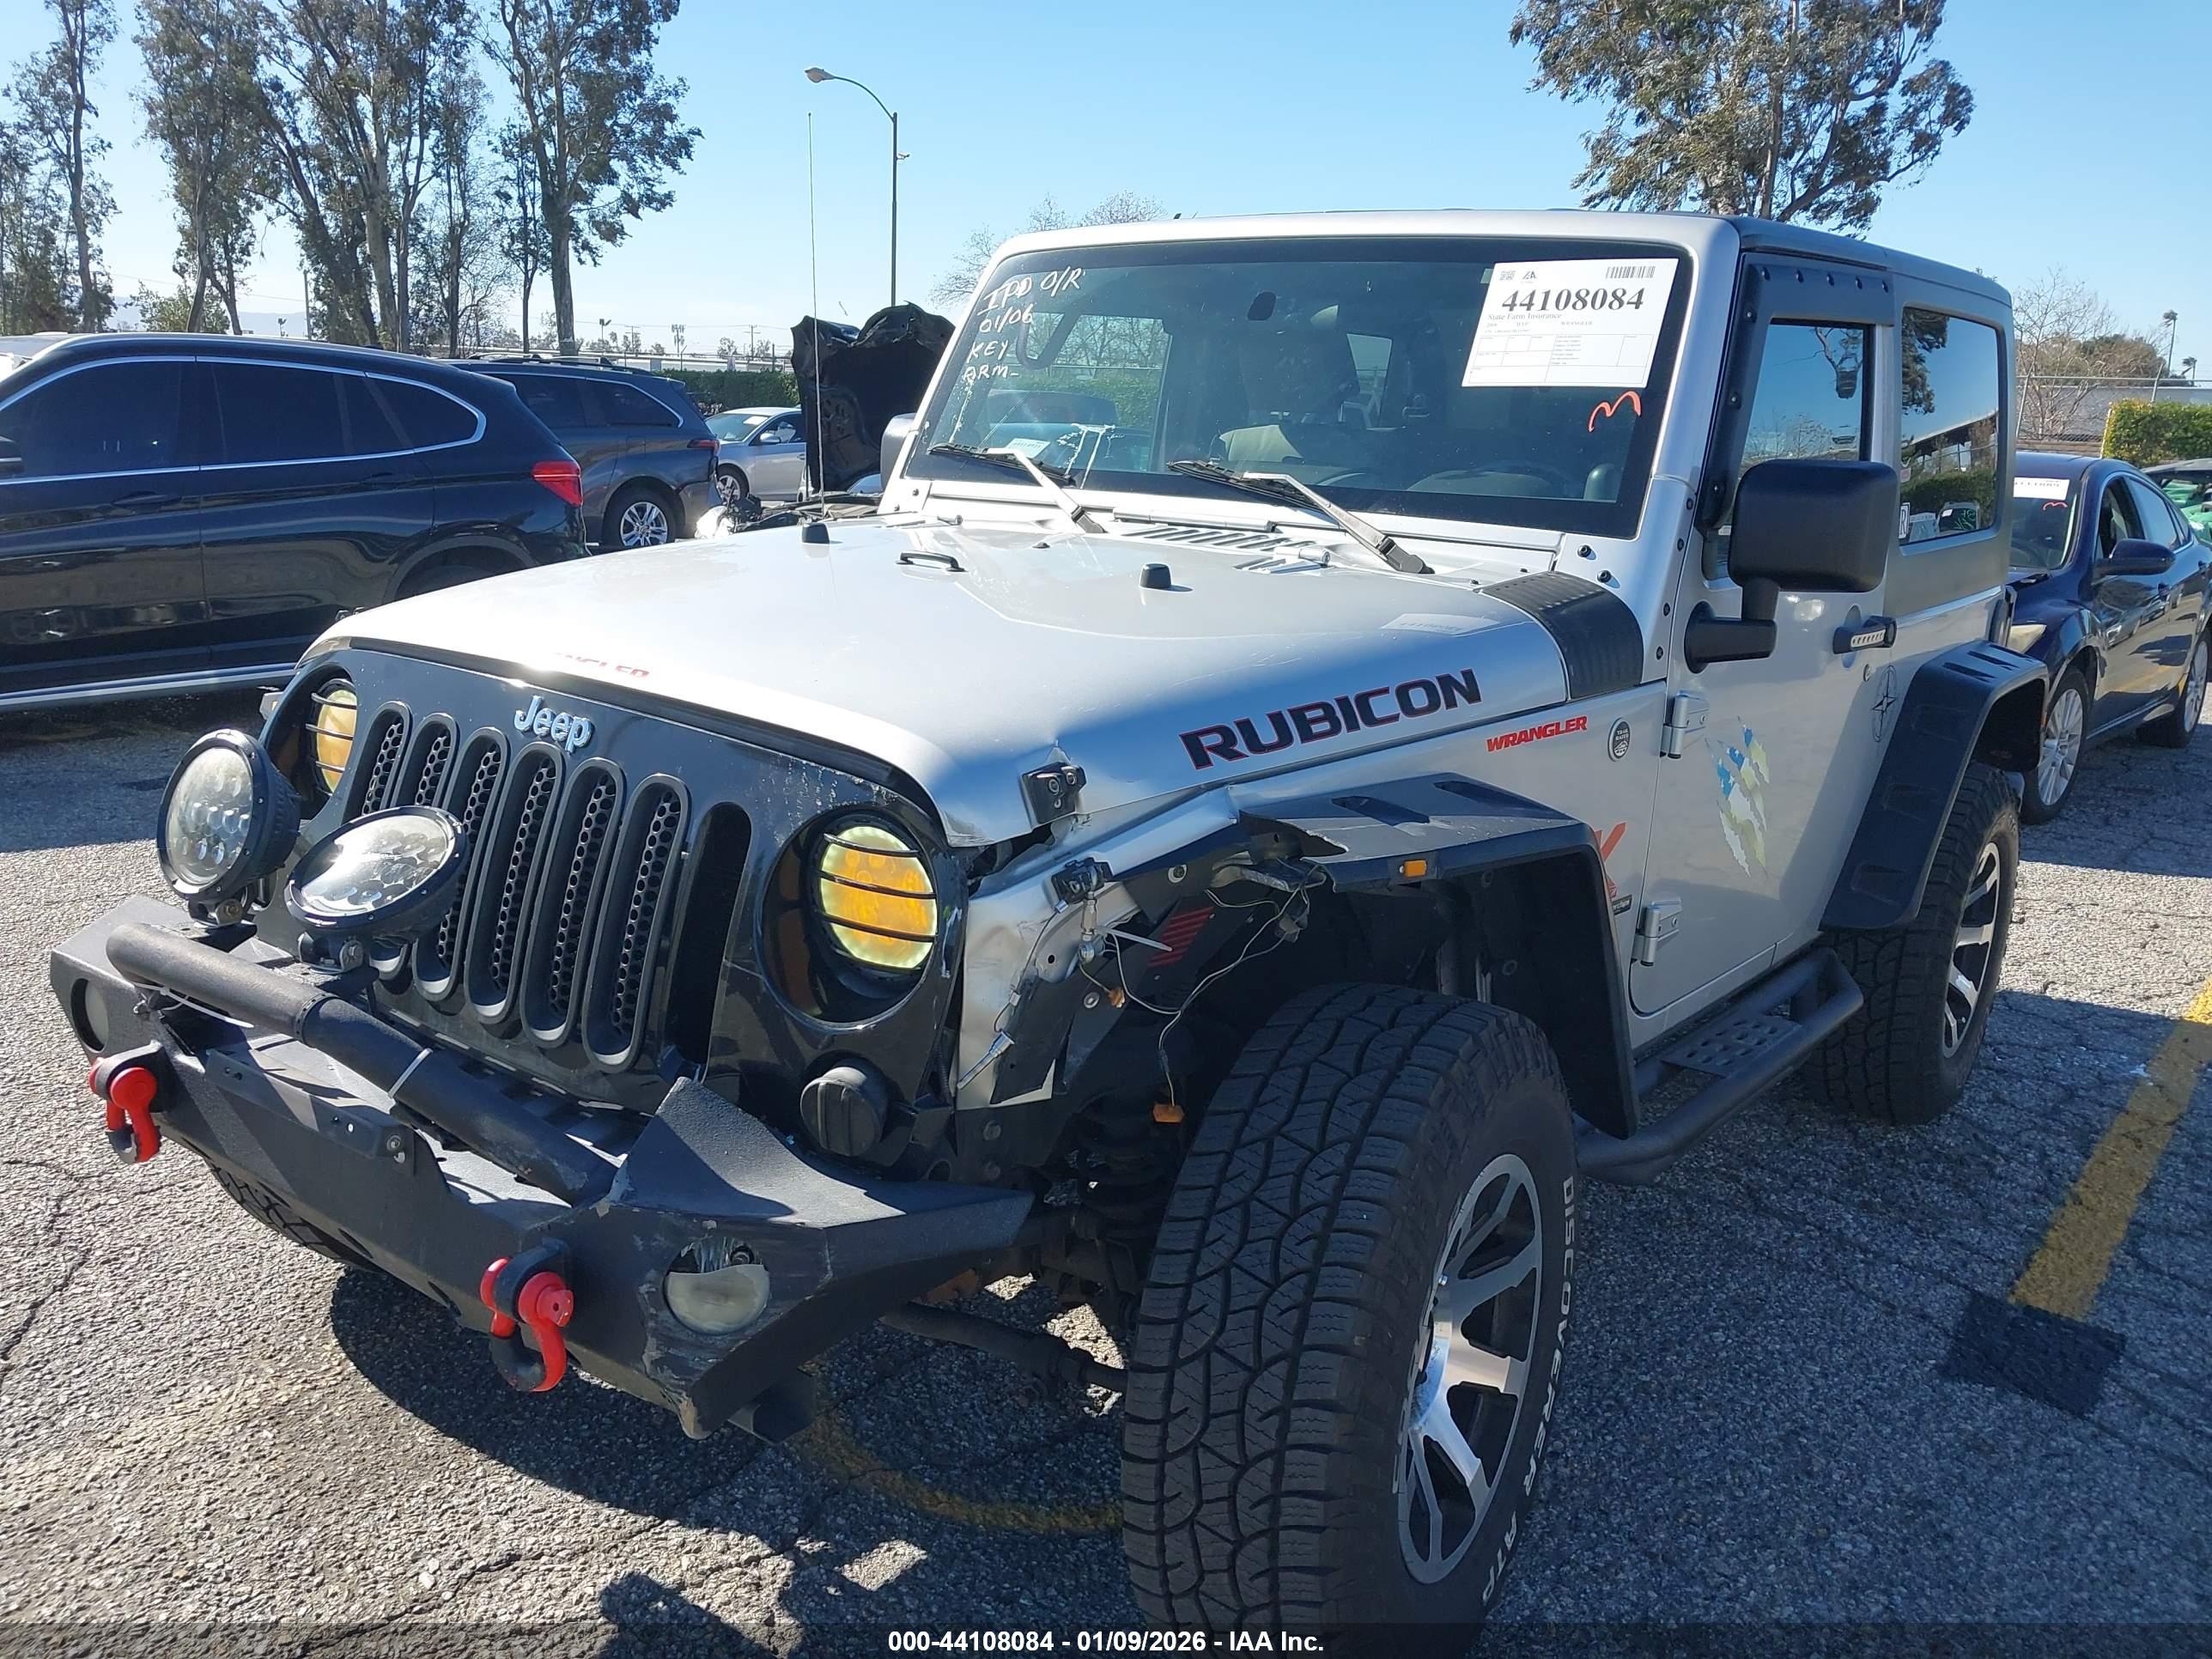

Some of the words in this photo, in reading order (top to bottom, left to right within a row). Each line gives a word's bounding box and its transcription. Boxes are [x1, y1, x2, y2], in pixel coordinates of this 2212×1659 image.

[1502, 288, 1645, 312] 44108084
[967, 340, 1008, 364] KEY
[514, 696, 593, 754] Jeep
[1179, 669, 1482, 770] RUBICON
[1486, 715, 1588, 752] WRANGLER
